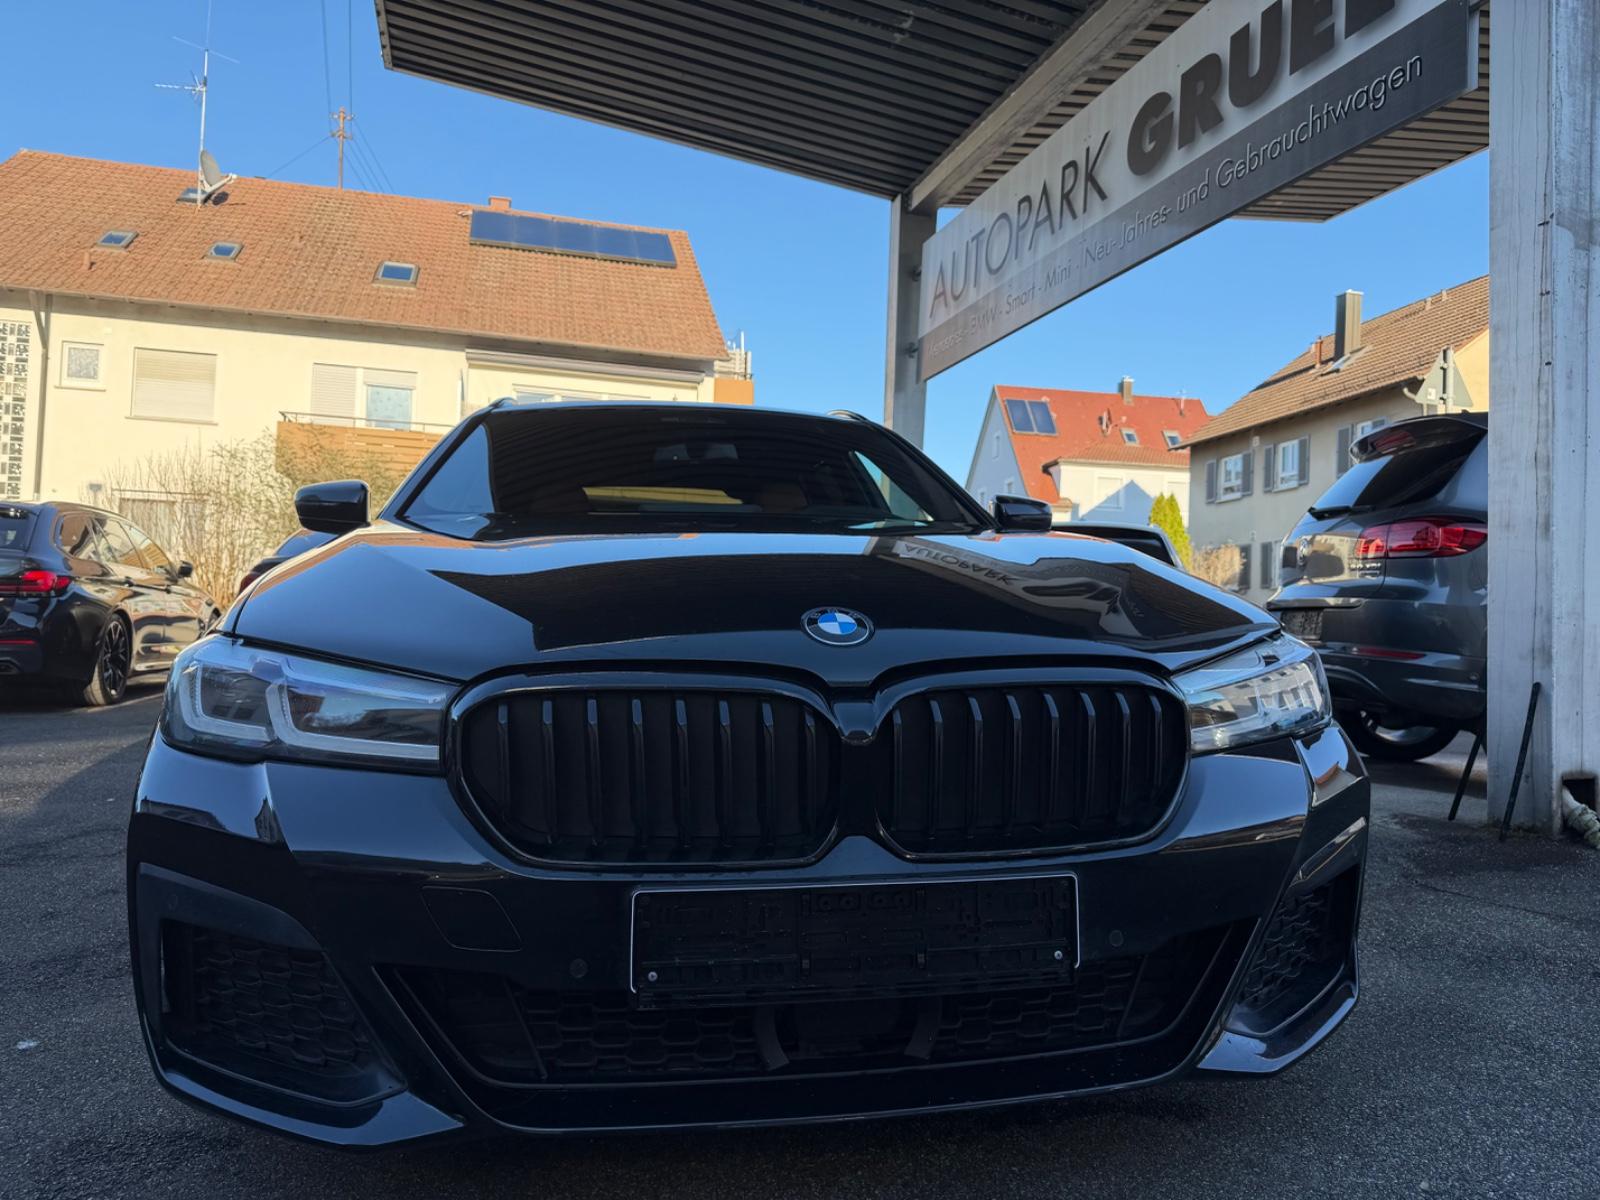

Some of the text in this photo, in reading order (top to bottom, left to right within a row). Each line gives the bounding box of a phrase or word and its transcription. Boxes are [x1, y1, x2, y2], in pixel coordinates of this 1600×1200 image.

[929, 129, 1111, 319] AUTOPARK
[1005, 281, 1036, 315] Smart
[1044, 259, 1072, 292] Mini
[1176, 167, 1210, 213] und
[1216, 55, 1423, 188] Gebrauchtwagen
